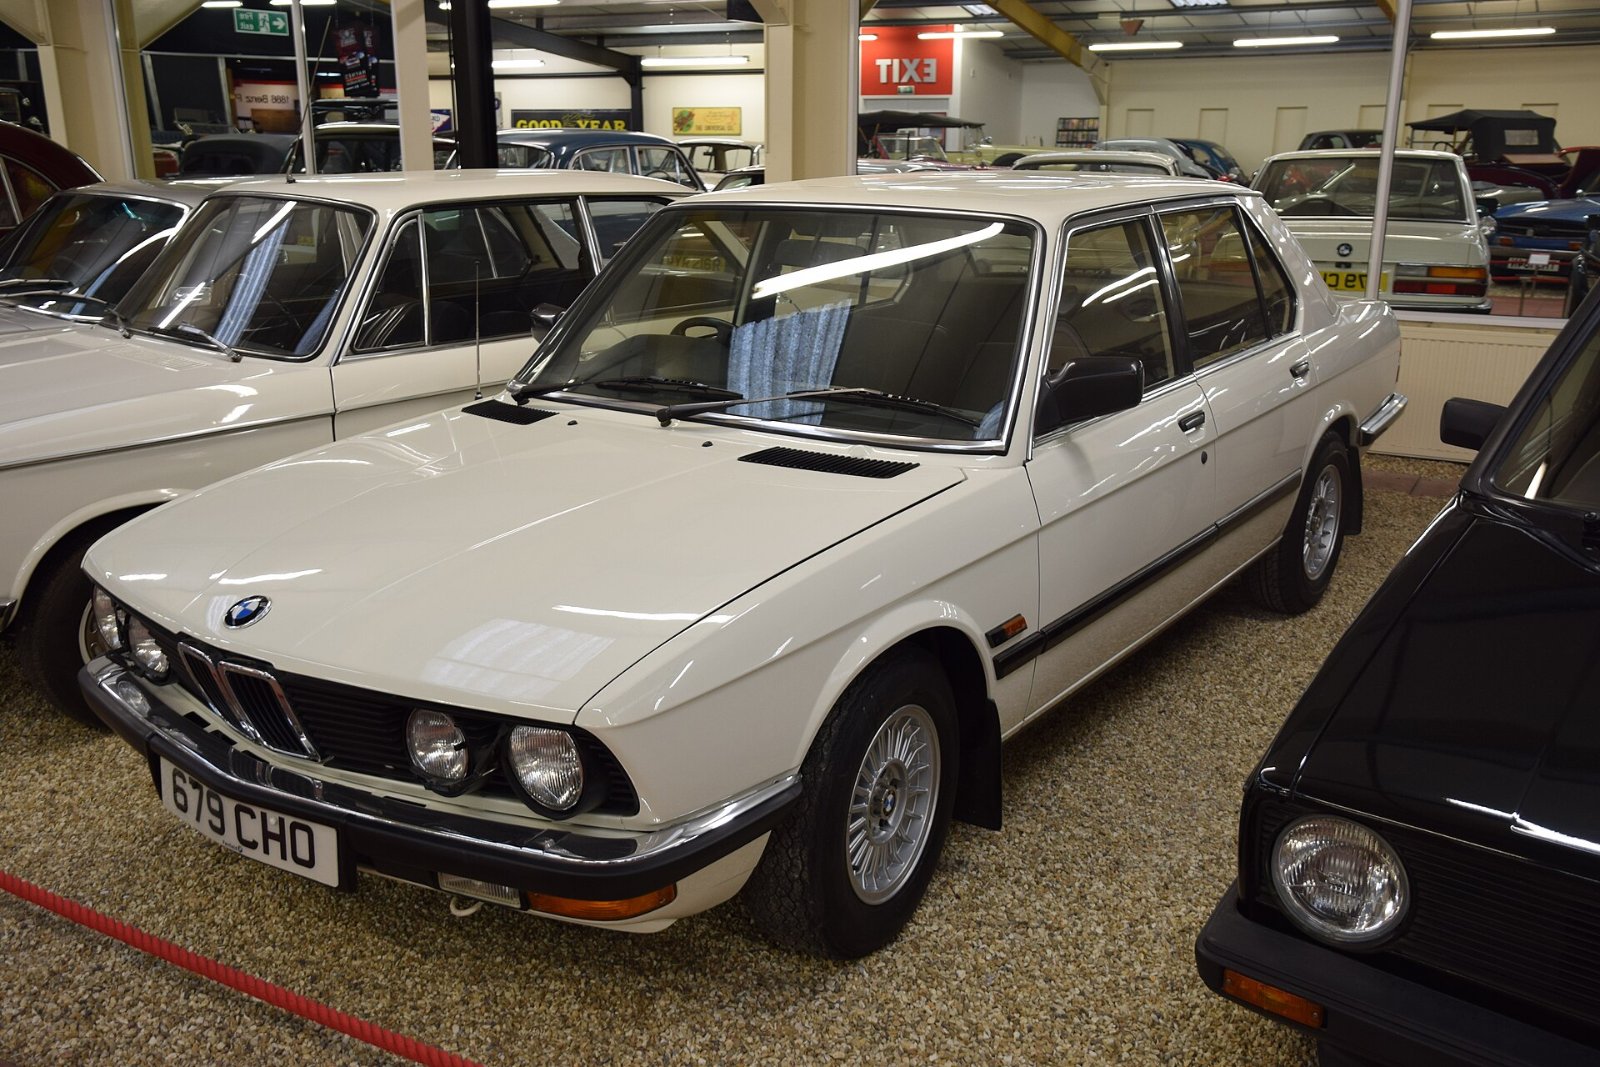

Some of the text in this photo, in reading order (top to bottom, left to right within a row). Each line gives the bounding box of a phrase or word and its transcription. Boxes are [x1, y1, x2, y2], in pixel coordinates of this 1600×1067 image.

[516, 120, 626, 131] GOOD YEAR
[172, 767, 315, 869] 679 CHO
